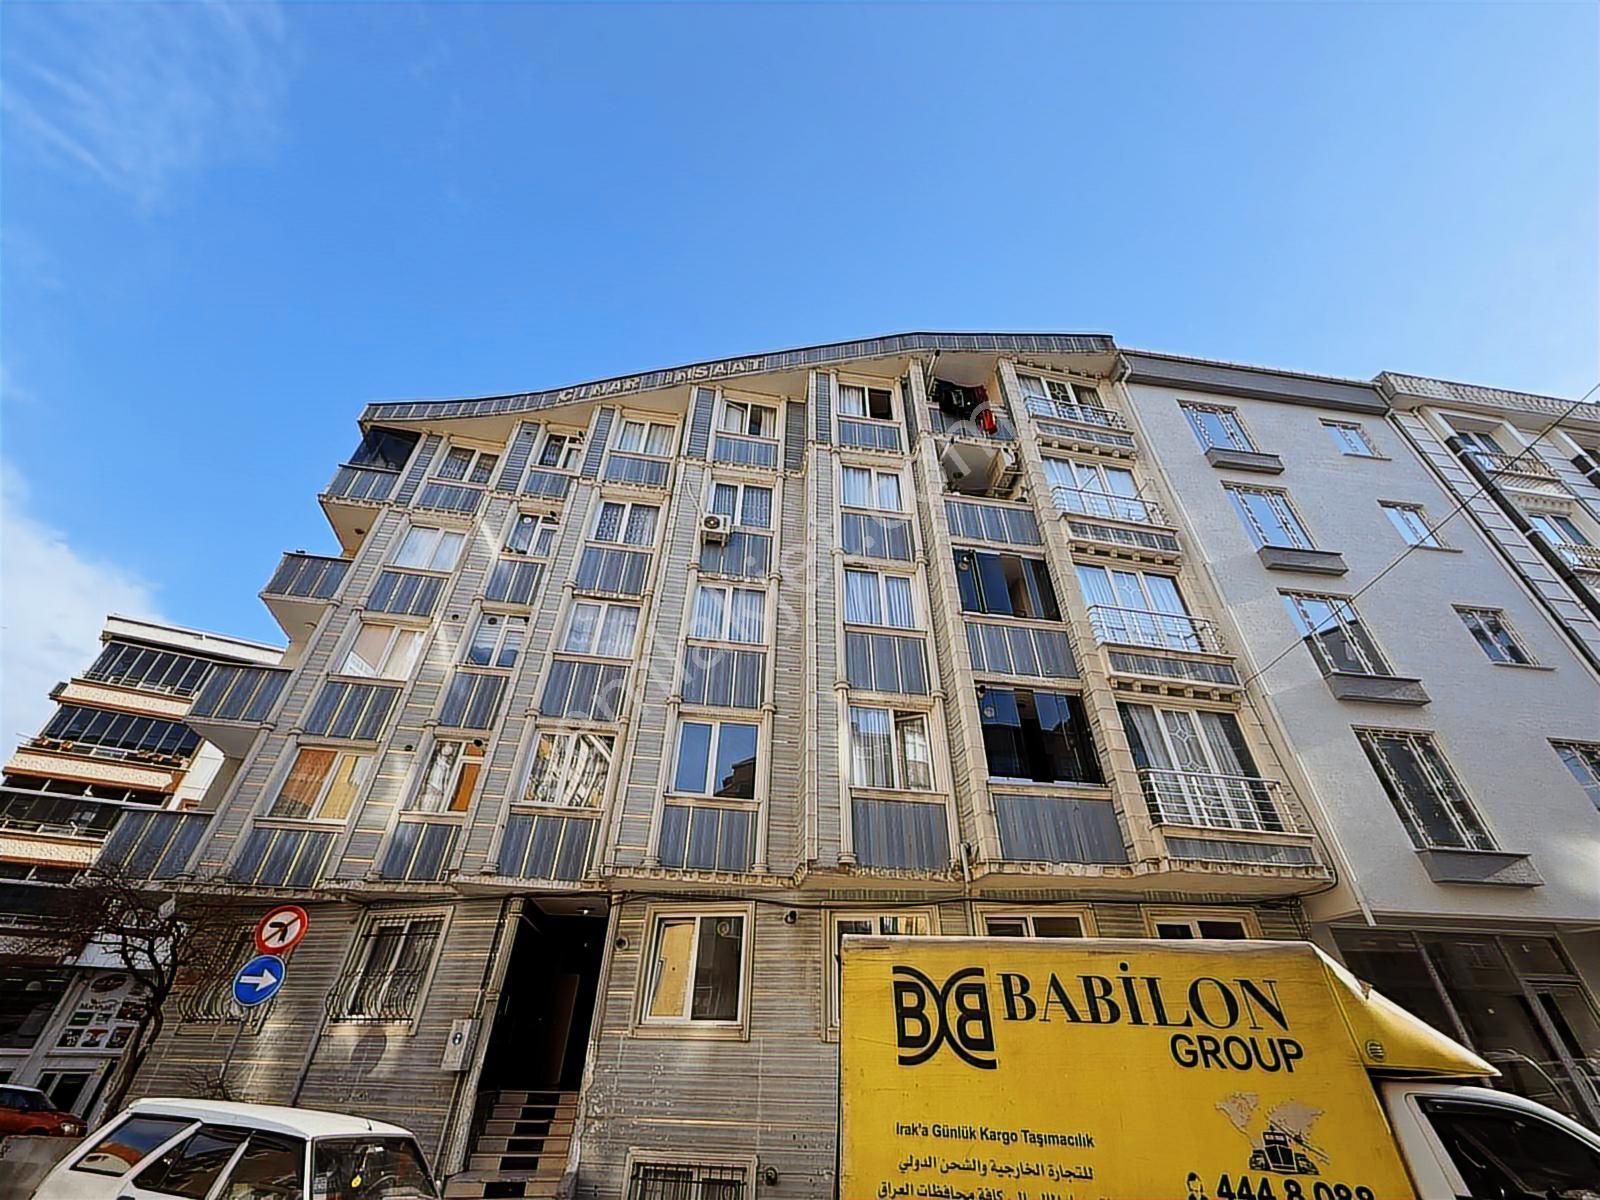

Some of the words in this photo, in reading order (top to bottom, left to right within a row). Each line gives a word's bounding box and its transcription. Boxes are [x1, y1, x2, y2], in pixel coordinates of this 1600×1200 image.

[997, 962, 1289, 1031] BABİLON
[1170, 1034, 1303, 1072] GROUP
[896, 1122, 929, 1137] Irak'a
[932, 1124, 976, 1140] Günlük
[980, 1128, 1018, 1145] Kargo
[1021, 1130, 1095, 1149] Taşımacılık
[898, 1155, 937, 1174] الدولي
[939, 1157, 988, 1176] والشحن
[990, 1160, 1045, 1179] الخارجية
[1047, 1163, 1094, 1182] للتجارة
[878, 1181, 914, 1199] العراق
[1217, 1174, 1277, 1200] 444
